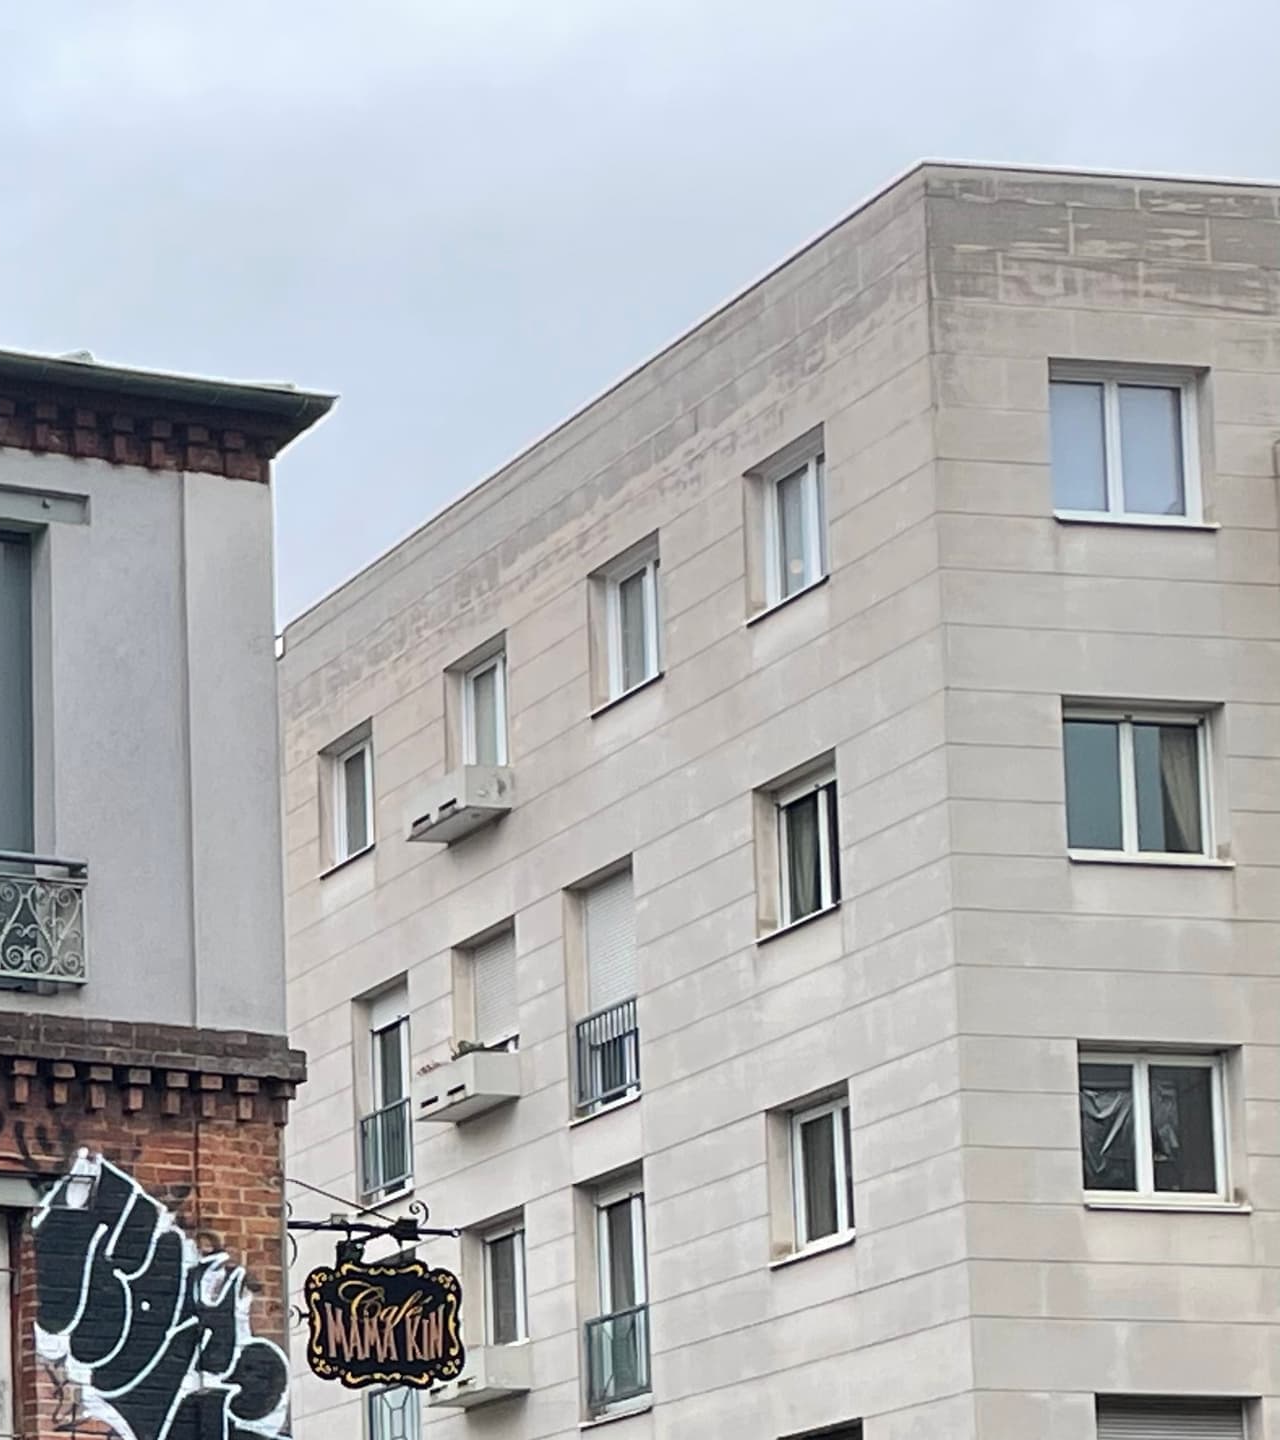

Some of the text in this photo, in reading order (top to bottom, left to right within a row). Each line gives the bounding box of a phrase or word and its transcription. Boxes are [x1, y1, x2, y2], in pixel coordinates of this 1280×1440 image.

[338, 1280, 433, 1328] Café
[324, 1302, 445, 1362] MAMA KIN
